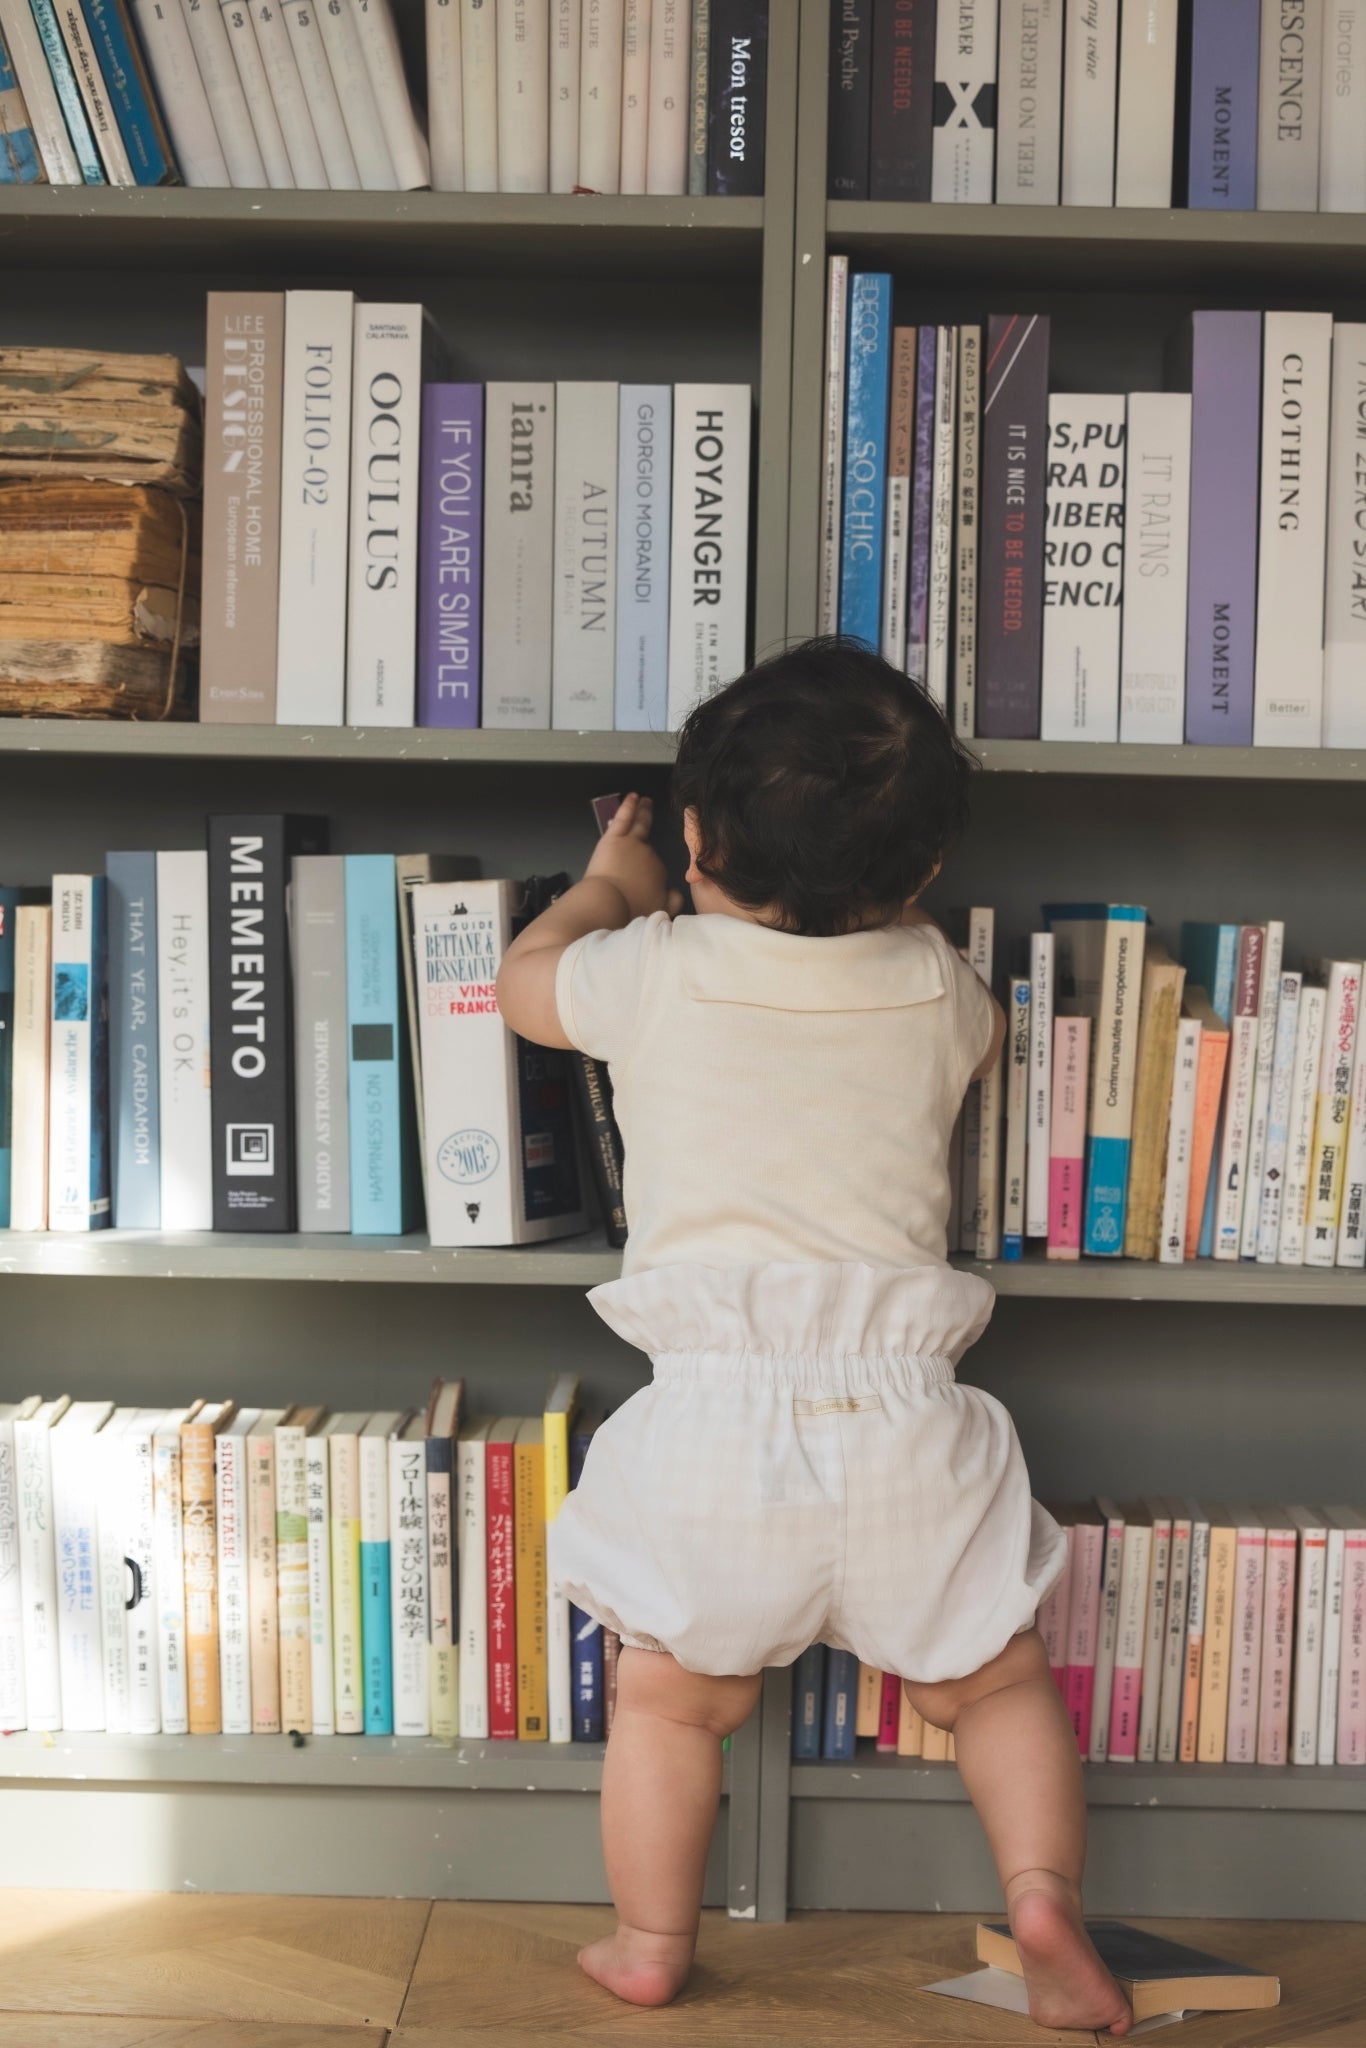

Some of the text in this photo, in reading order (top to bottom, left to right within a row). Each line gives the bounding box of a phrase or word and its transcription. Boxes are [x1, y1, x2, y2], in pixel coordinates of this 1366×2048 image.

[153, 4, 165, 20] 1
[232, 12, 245, 28] 3
[259, 7, 273, 23] 4
[297, 10, 310, 27] 5
[327, 0, 342, 16] 6
[515, 12, 526, 43] LIFE
[559, 19, 569, 50] LIFE
[588, 19, 599, 50] LIFE
[893, 18, 912, 38] BE
[626, 28, 637, 58] LIFE
[663, 29, 675, 60] LIFE
[837, 28, 860, 91] Psyche
[1085, 36, 1100, 81] wine
[1335, 8, 1356, 98] libraries
[516, 80, 524, 94] 1
[559, 88, 570, 101] 3
[587, 87, 599, 100] 4
[627, 95, 638, 109] 5
[663, 96, 675, 111] 6
[729, 36, 751, 162] Mon tresor
[1016, 3, 1040, 189] FEEL NO REGRET
[1211, 86, 1232, 198] MOMENT
[223, 315, 265, 334] LIFE
[221, 338, 248, 474] DESIGN
[302, 343, 334, 507] FOLIO-02
[1047, 422, 1127, 455] S,PU
[244, 338, 265, 567] PROFESSIONAL HOME
[508, 400, 548, 514] ianra
[1277, 353, 1303, 532] CLOTHING
[365, 371, 404, 592] OCULUS
[633, 403, 654, 604] GIORGIO MORANDI
[692, 409, 724, 608] HOYANGER
[849, 441, 877, 562] SO CHIC
[1002, 423, 1028, 638] IT IS NICE TO BE NEEDED.
[1046, 502, 1126, 530] IBER
[1138, 453, 1173, 579] IT RAINS
[223, 495, 240, 629] European reference
[436, 418, 473, 700] IF YOU ARE SIMPLE
[580, 480, 609, 633] AUTUMN
[708, 623, 719, 648] EIN
[1211, 601, 1232, 716] MOMENT
[374, 657, 385, 708] ASSOULINE
[61, 890, 72, 933] PATRICK
[424, 920, 495, 934] LE GUIDE
[229, 834, 267, 1080] MEMENTO
[425, 933, 495, 960] BETTANE &
[425, 956, 497, 984] DESSEAUVE
[426, 984, 498, 1001] DES VINS
[426, 1000, 498, 1017] DE FRANCE
[1104, 936, 1128, 1109] Communautés européennes
[128, 897, 151, 1165] THAT YEAR, CARDAMOM
[64, 1030, 79, 1100] Avalanche
[581, 1055, 608, 1123] PREMIUM
[312, 1019, 333, 1211] RADIO ASTRONOMER
[363, 1074, 385, 1202] HAPPINESS IS ON
[220, 1441, 237, 1559] SINGLE TASK
[307, 1458, 324, 1524] 地宝論
[399, 1452, 425, 1639] フロー体験 喜びの現象学
[431, 1492, 448, 1568] 家守綺譚
[489, 1513, 507, 1651] ソウル・オブ・マネー
